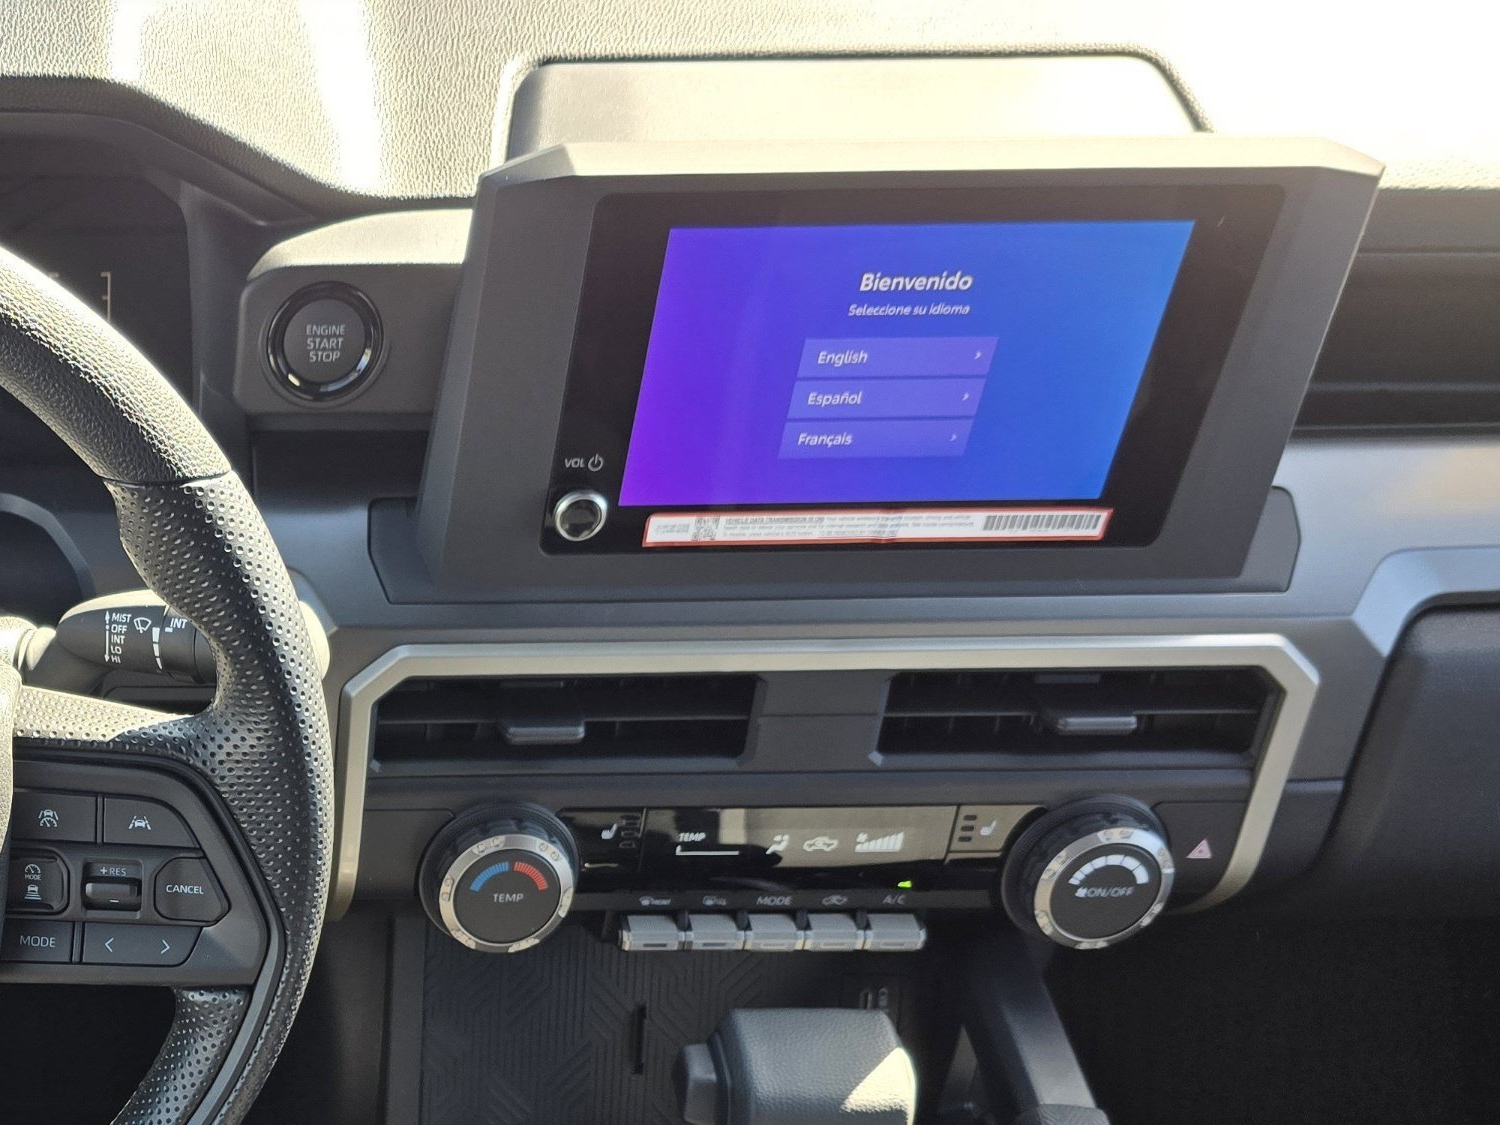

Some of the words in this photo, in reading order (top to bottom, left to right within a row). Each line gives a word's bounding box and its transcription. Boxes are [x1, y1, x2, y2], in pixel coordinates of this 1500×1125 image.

[859, 270, 973, 292] Bienvenido
[848, 303, 912, 317] Seleccione
[913, 306, 927, 316] su
[929, 303, 970, 315] idioma
[306, 324, 346, 336] ENGINE
[306, 337, 344, 350] START
[309, 350, 340, 363] STOP
[817, 350, 869, 368] English
[807, 391, 863, 407] Español
[797, 433, 853, 448] Français
[564, 457, 585, 469] VOL
[111, 612, 132, 623] MIST
[170, 617, 188, 629] INT
[111, 624, 128, 634] OFF
[111, 634, 125, 645] INT
[110, 645, 122, 654] LO
[110, 655, 122, 664] HI
[679, 832, 706, 842] TEMP
[24, 873, 42, 881] MODE
[166, 884, 204, 895] CANCEL
[1087, 886, 1135, 898] ON/OFF
[493, 892, 524, 903] TEMP
[756, 895, 793, 906] MODE
[882, 894, 907, 905] A/C
[19, 934, 56, 949] MODE
